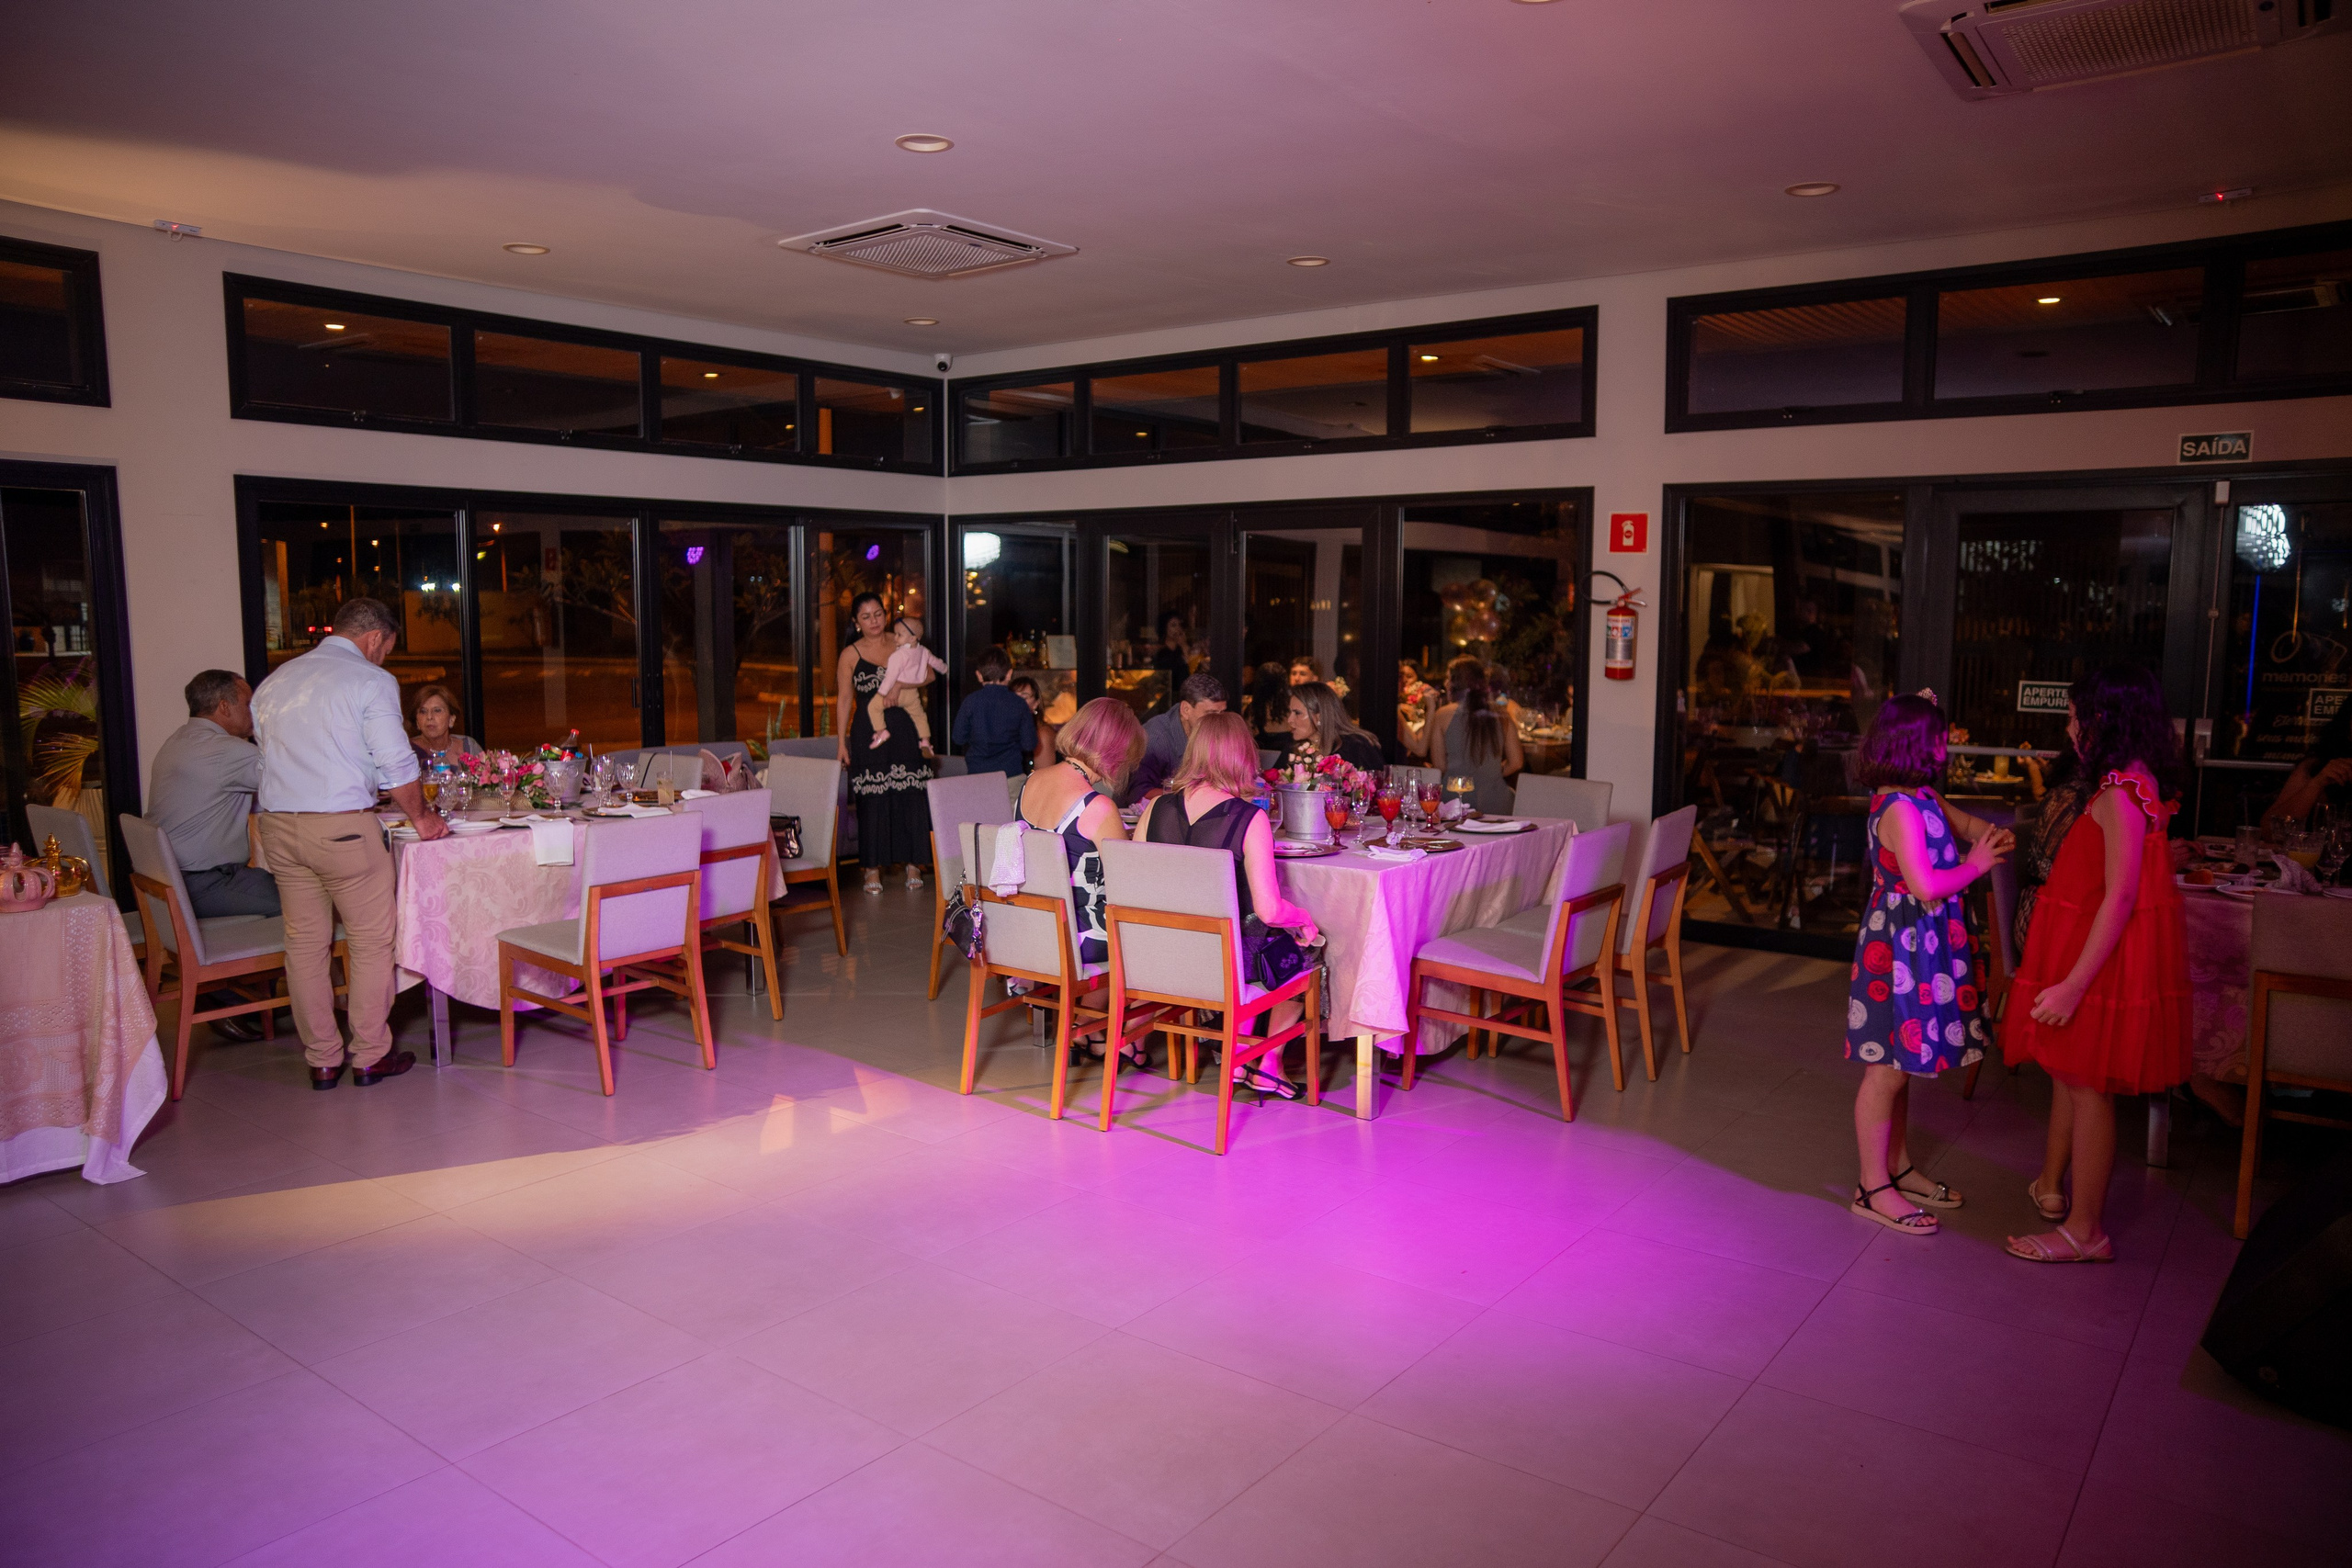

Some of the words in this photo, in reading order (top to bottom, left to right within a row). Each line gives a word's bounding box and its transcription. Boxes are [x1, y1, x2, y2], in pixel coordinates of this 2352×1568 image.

[2182, 437, 2247, 457] SAÍDA
[2262, 671, 2346, 683] memories
[2023, 687, 2069, 698] APERTE
[2022, 696, 2070, 707] EMPURR
[2314, 694, 2348, 705] APE
